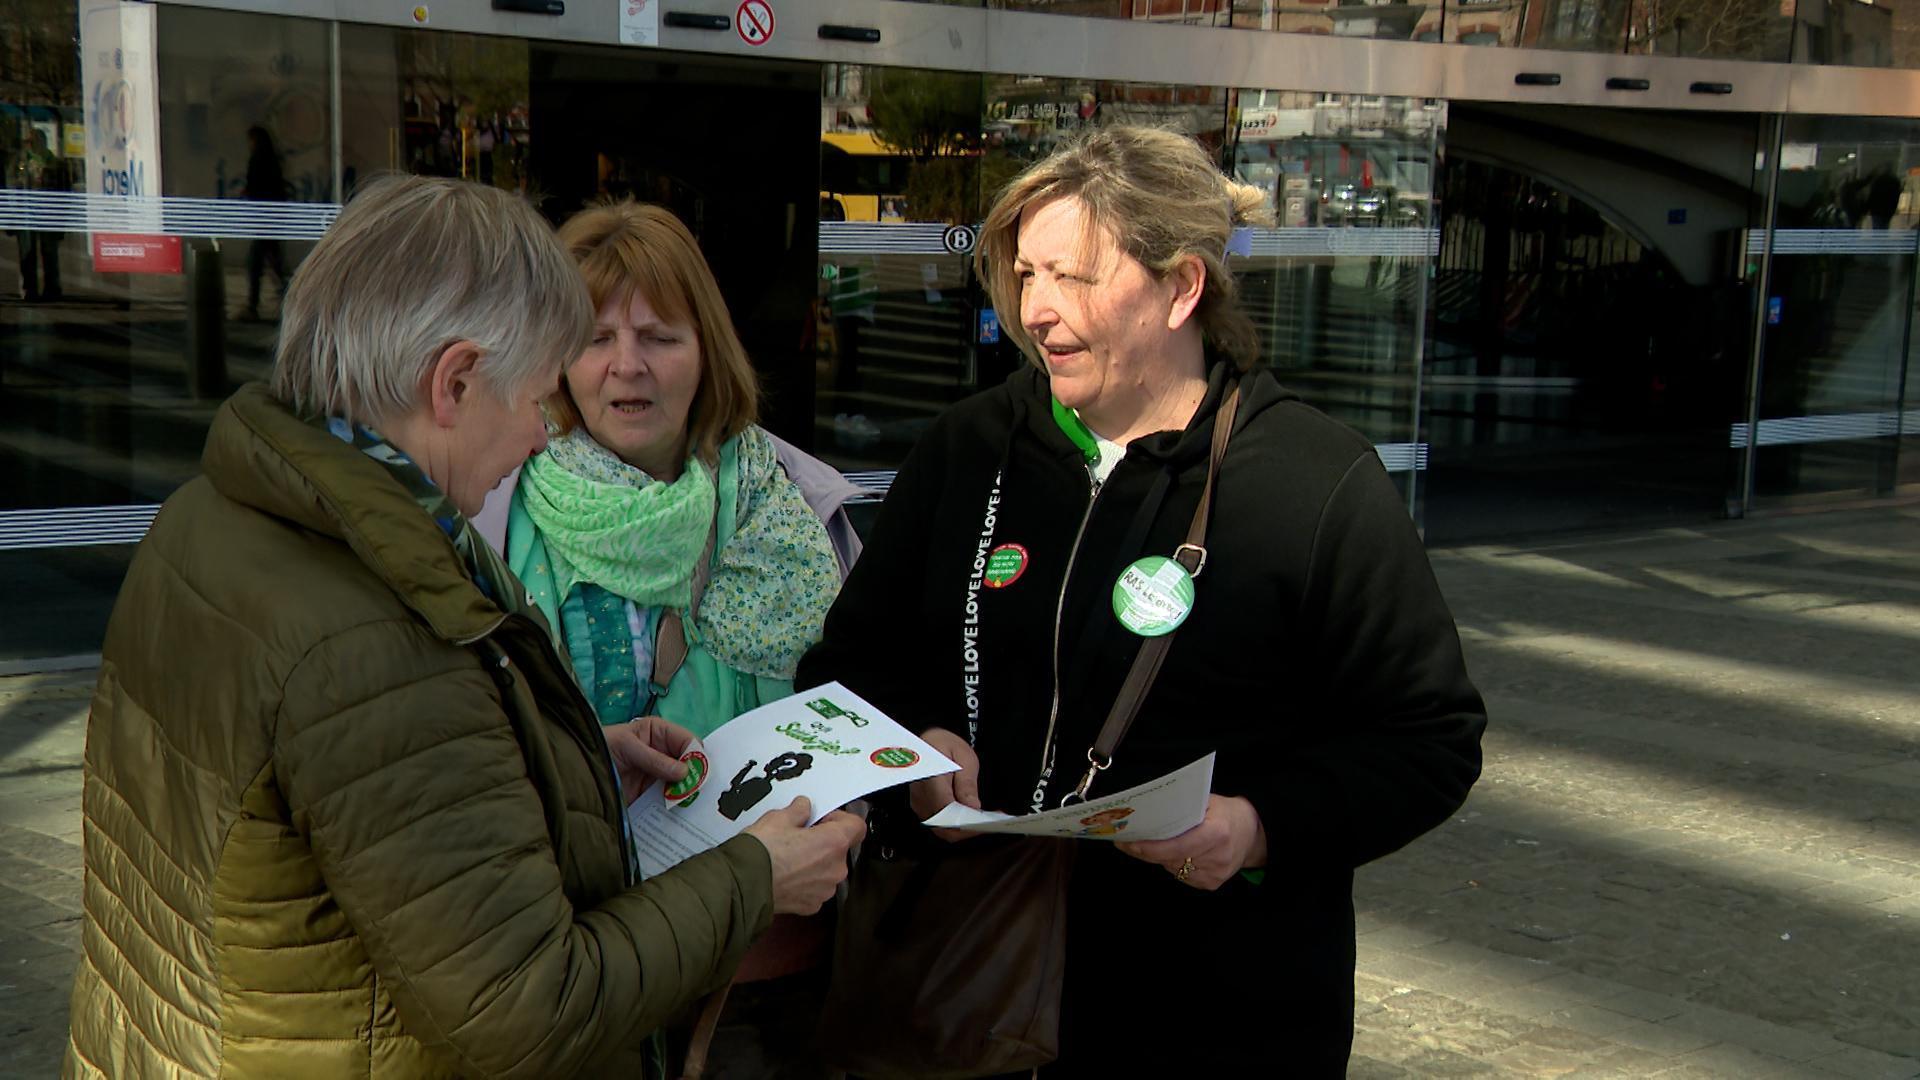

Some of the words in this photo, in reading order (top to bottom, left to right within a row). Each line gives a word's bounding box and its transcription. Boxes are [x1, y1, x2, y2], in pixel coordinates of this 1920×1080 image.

[981, 495, 1001, 537] LOVE
[971, 537, 993, 579] LOVE
[965, 579, 982, 625] LOVE
[963, 626, 979, 673] LOVE
[965, 673, 979, 720] LOVE
